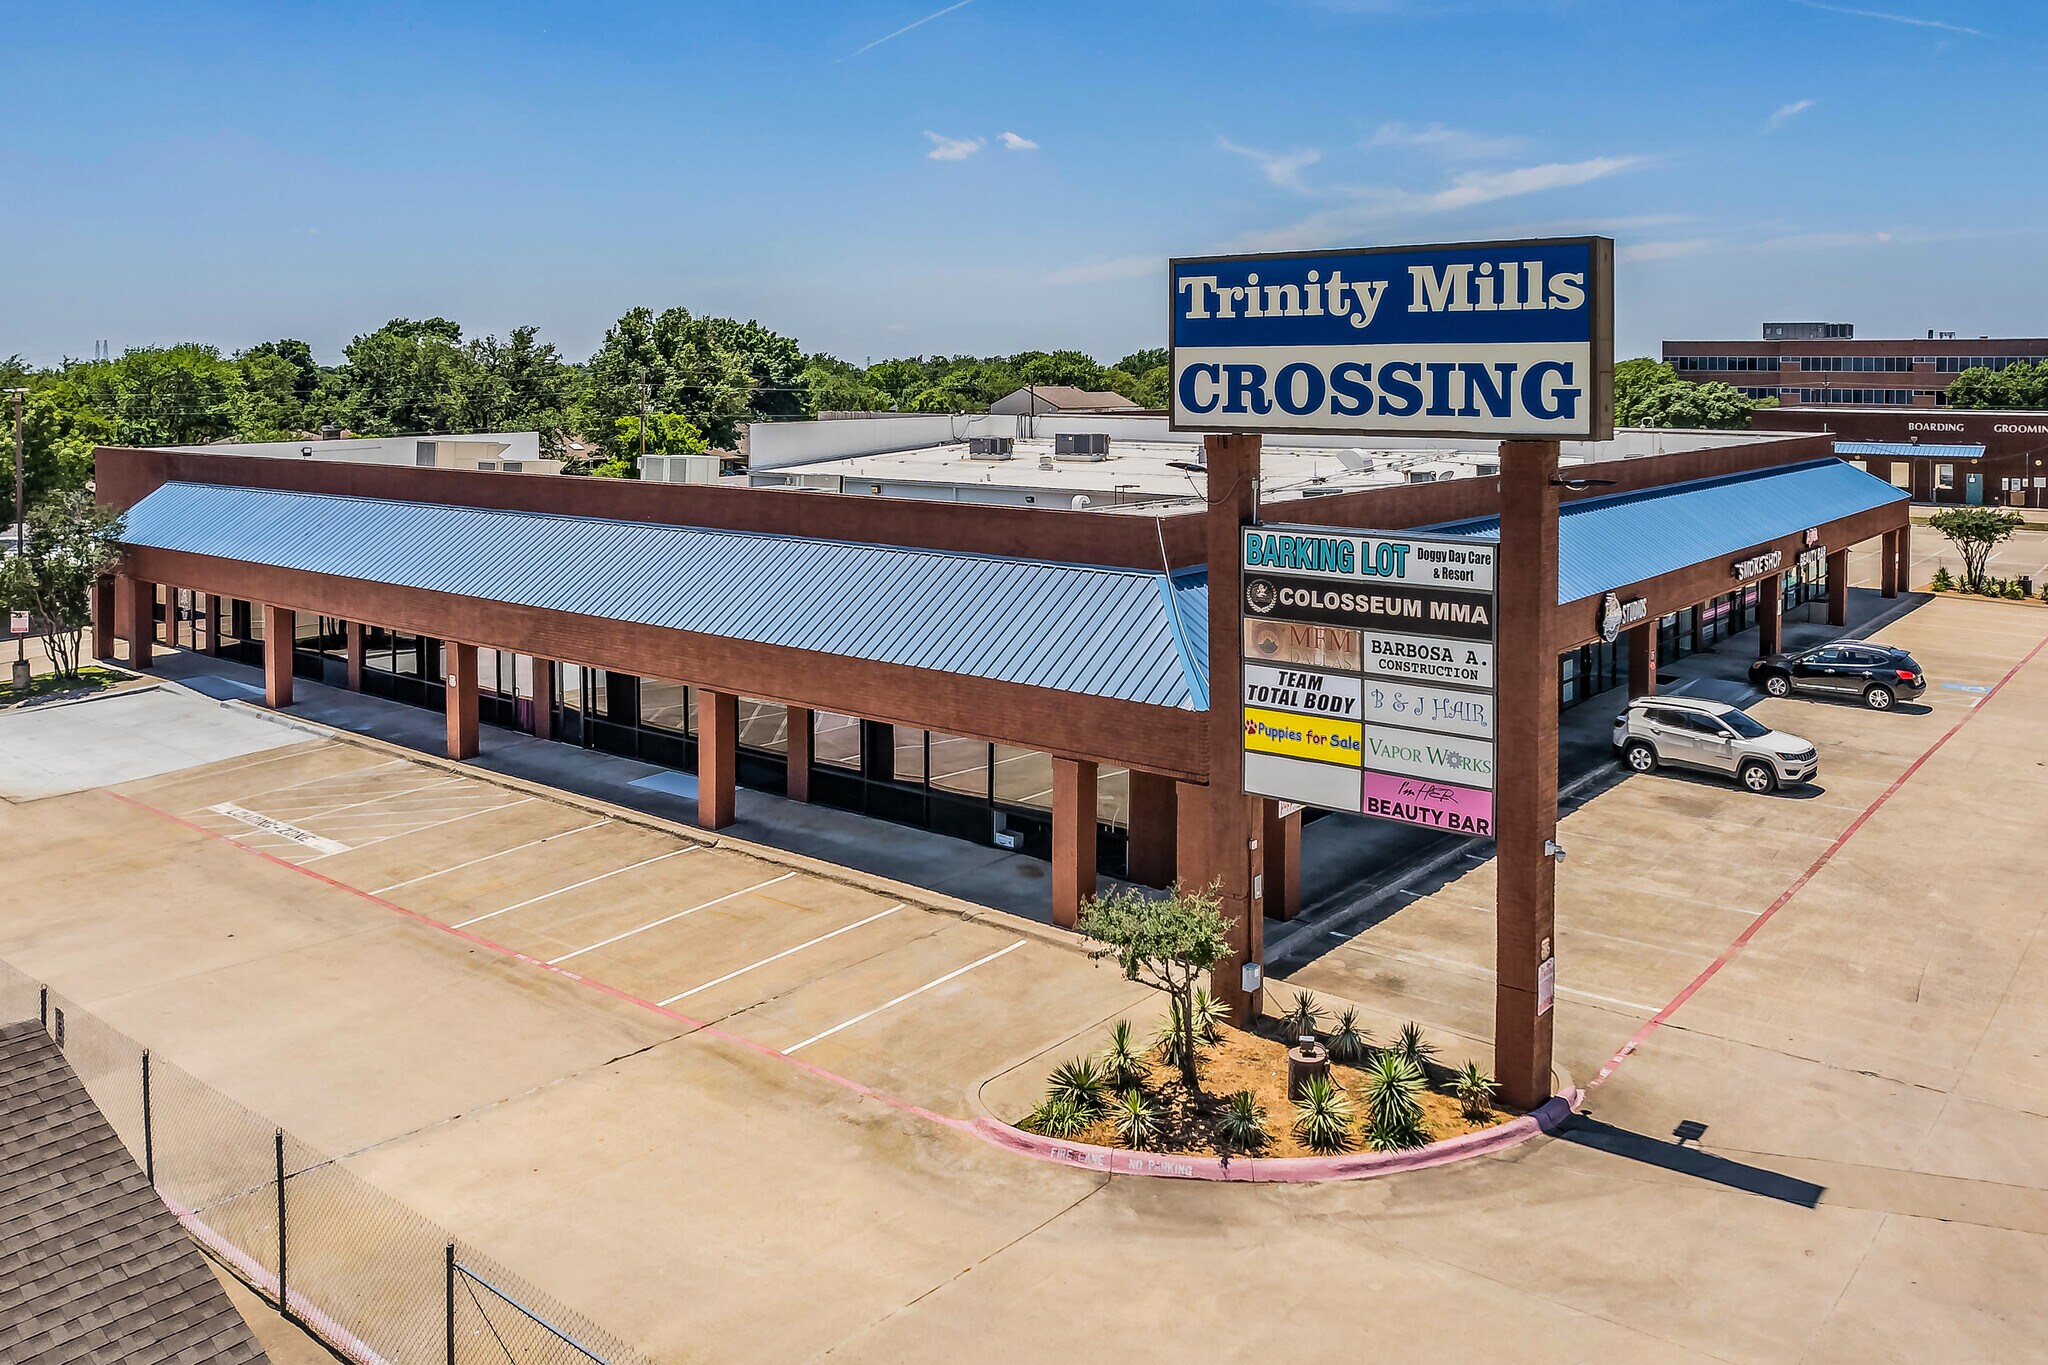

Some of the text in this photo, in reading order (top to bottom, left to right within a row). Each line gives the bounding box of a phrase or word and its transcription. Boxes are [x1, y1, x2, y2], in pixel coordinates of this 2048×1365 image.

[1178, 261, 1586, 329] Trinity Mills
[1178, 360, 1582, 420] CROSSING
[1908, 422, 1964, 432] BOARDING
[1246, 533, 1410, 578] BARKING LOT
[1417, 547, 1491, 565] Doggy Day Care
[1737, 550, 1782, 581] SMOKE SHOP
[1433, 567, 1474, 582] & Resort
[1280, 587, 1489, 625] COLOSSEUM MMA
[1289, 625, 1352, 653] MFM
[1289, 650, 1353, 670] DALLAS
[1371, 640, 1487, 667] BARBOSA A.
[1278, 671, 1323, 691] TEAM
[1378, 658, 1479, 681] CONSTRUCTION
[1248, 684, 1355, 715] TOTAL BODY
[1370, 688, 1488, 727] B & J HAIR
[1258, 722, 1360, 751] Puppies for Sale
[1369, 737, 1422, 763] VAPOR
[1367, 796, 1490, 835] BEAUTY BAR
[1050, 1146, 1105, 1167] FIRE LANE
[1128, 1158, 1193, 1177] NO PARKING
